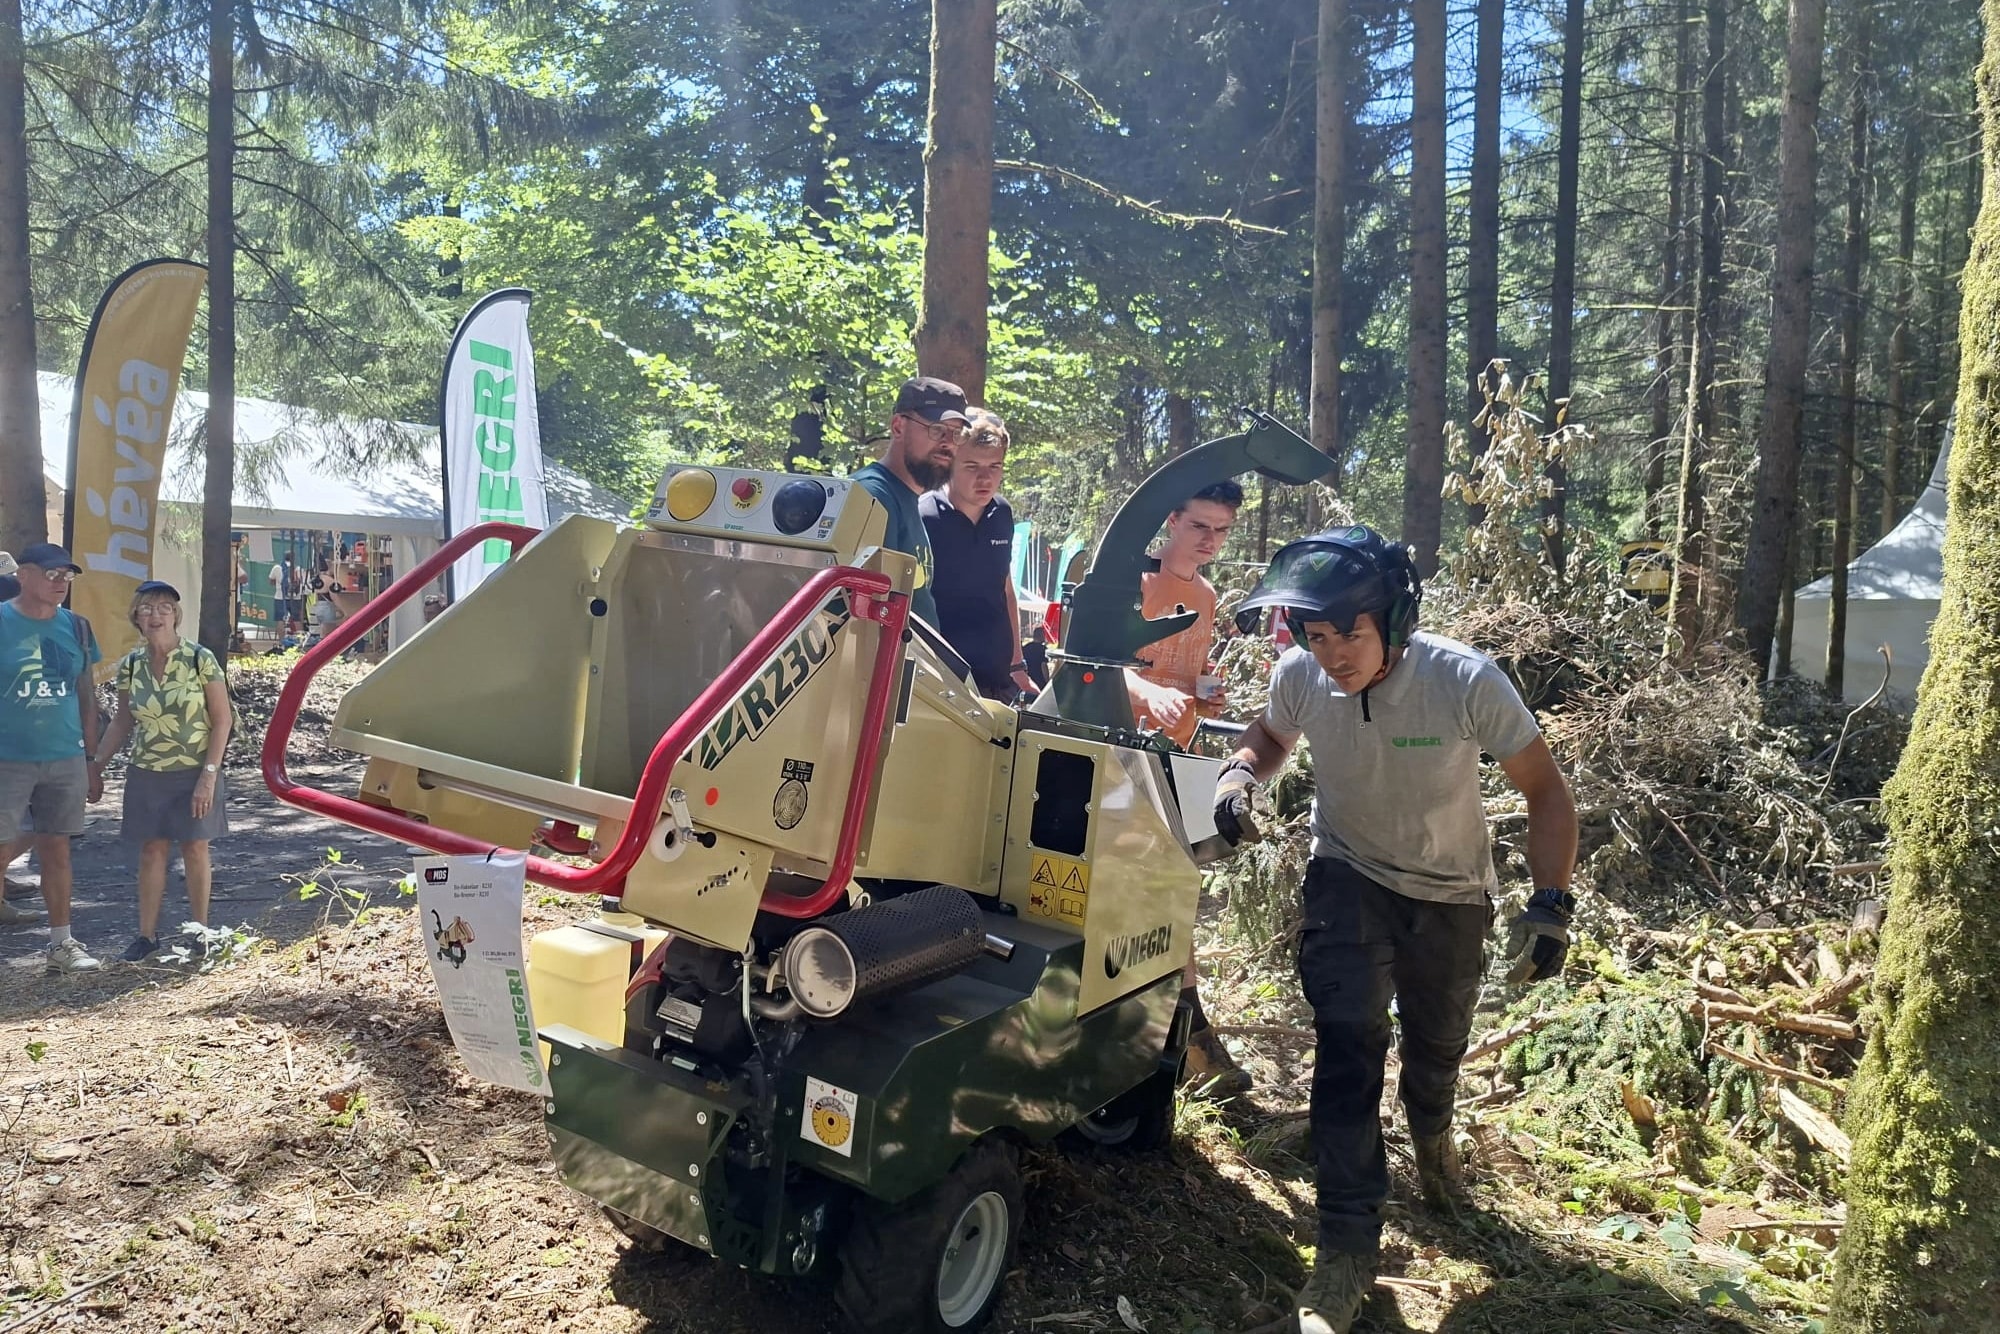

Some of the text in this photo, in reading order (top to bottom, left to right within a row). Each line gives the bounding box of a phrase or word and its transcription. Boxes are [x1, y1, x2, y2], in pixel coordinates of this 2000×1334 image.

[83, 358, 169, 580] hévéa
[735, 501, 751, 509] STOP
[240, 601, 267, 620] évéa
[17, 681, 67, 697] J & J
[740, 615, 827, 731] R230
[1127, 923, 1172, 968] NEGRI
[505, 969, 533, 1048] NEGRI
